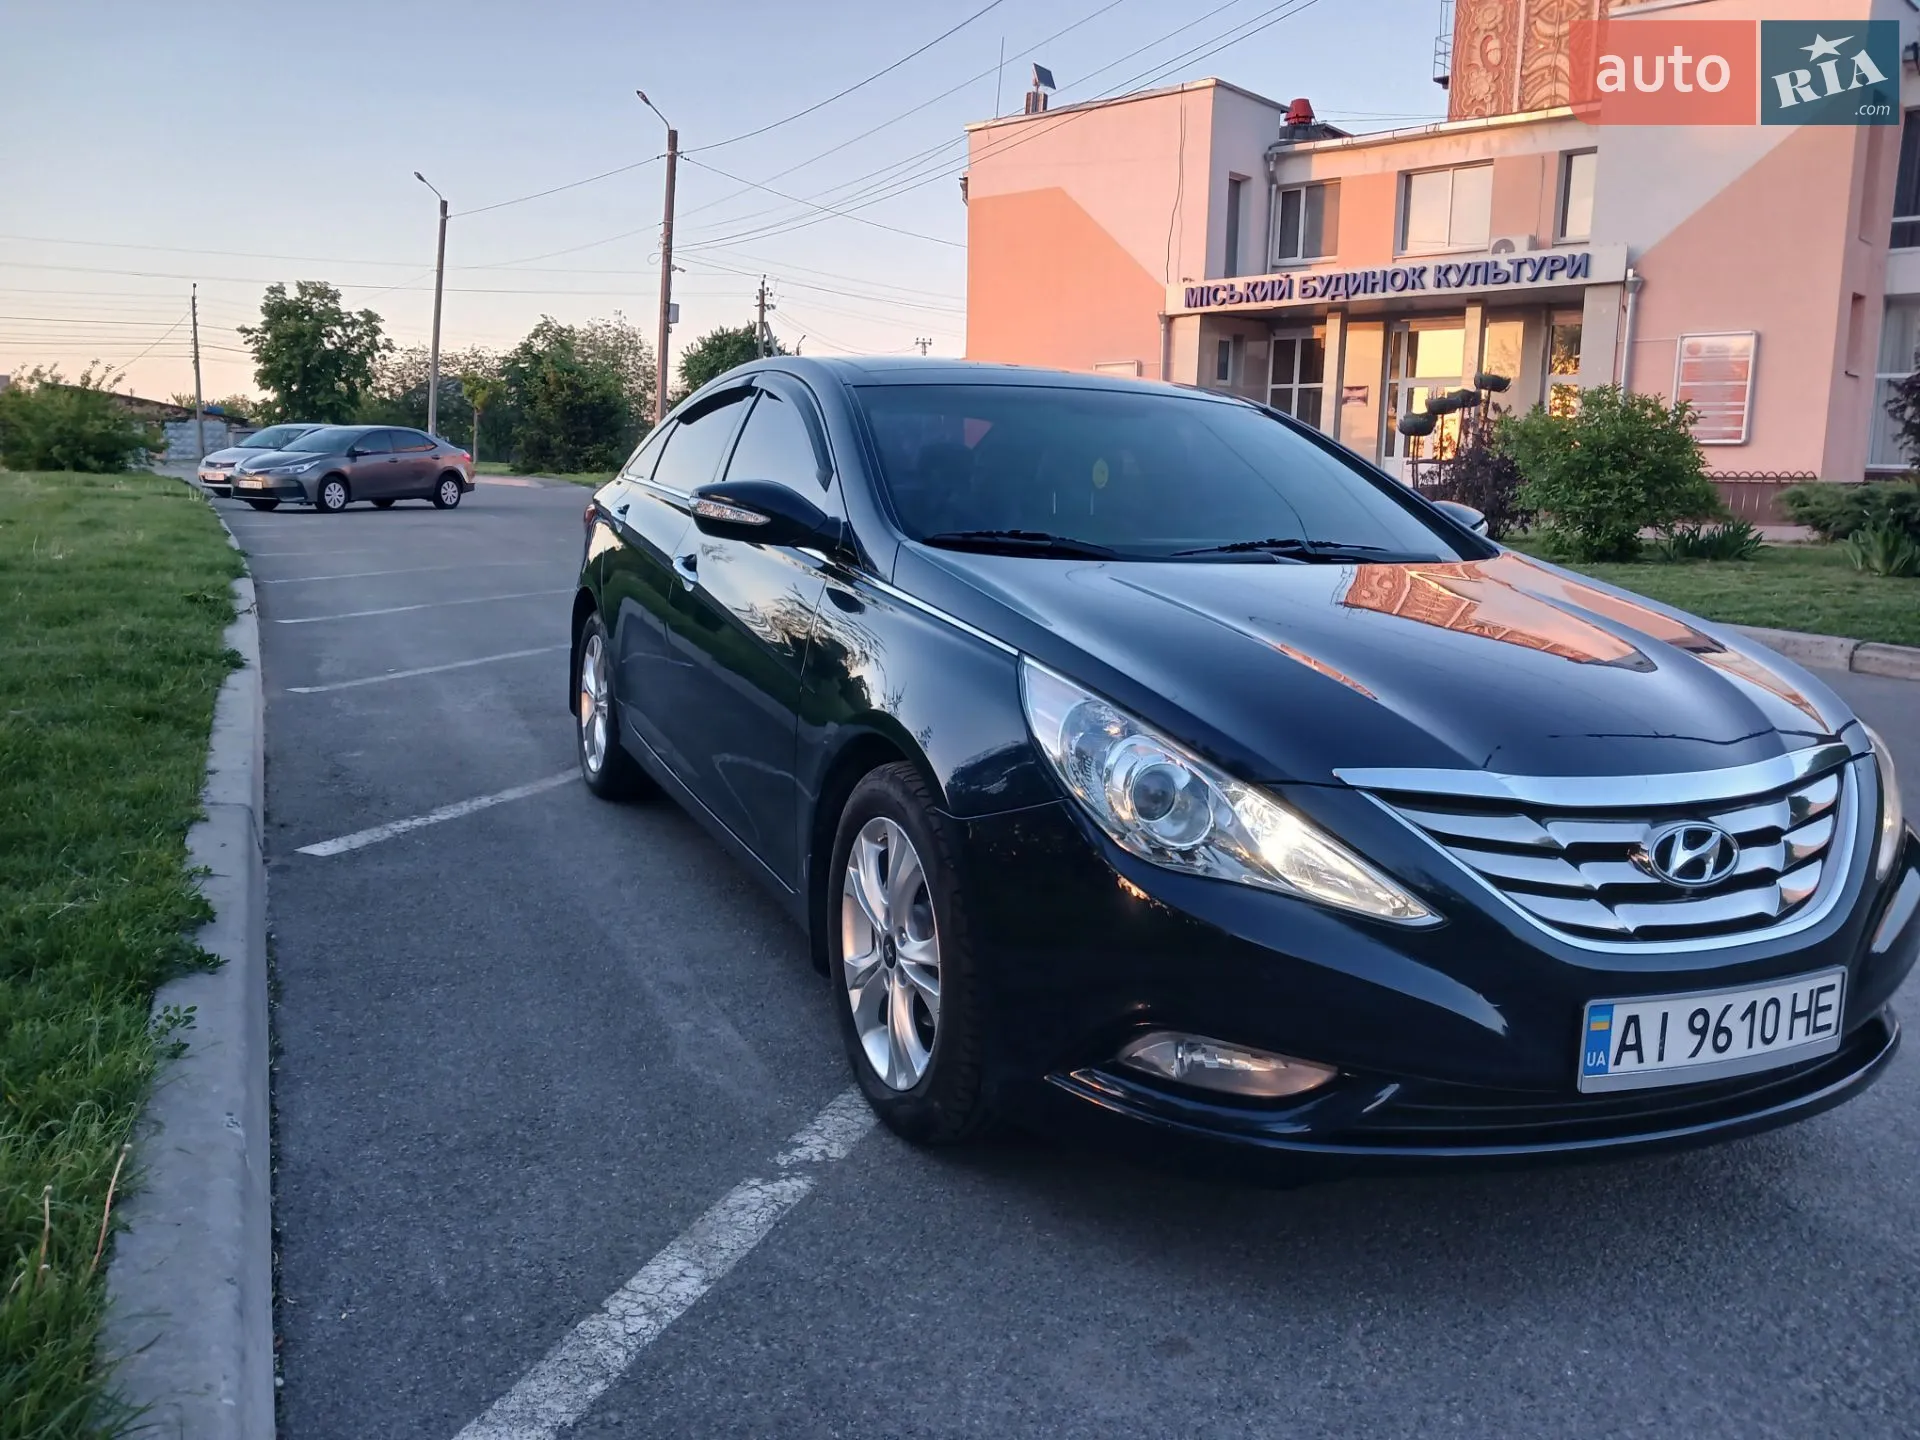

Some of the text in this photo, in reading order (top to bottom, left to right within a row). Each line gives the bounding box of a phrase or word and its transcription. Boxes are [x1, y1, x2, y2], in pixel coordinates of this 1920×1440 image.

[1184, 252, 1591, 308] МІСЬКИЙ БУДИНОК КУЛЬТУРИ
[1687, 997, 1781, 1059] 9610
[1586, 1050, 1606, 1067] UA
